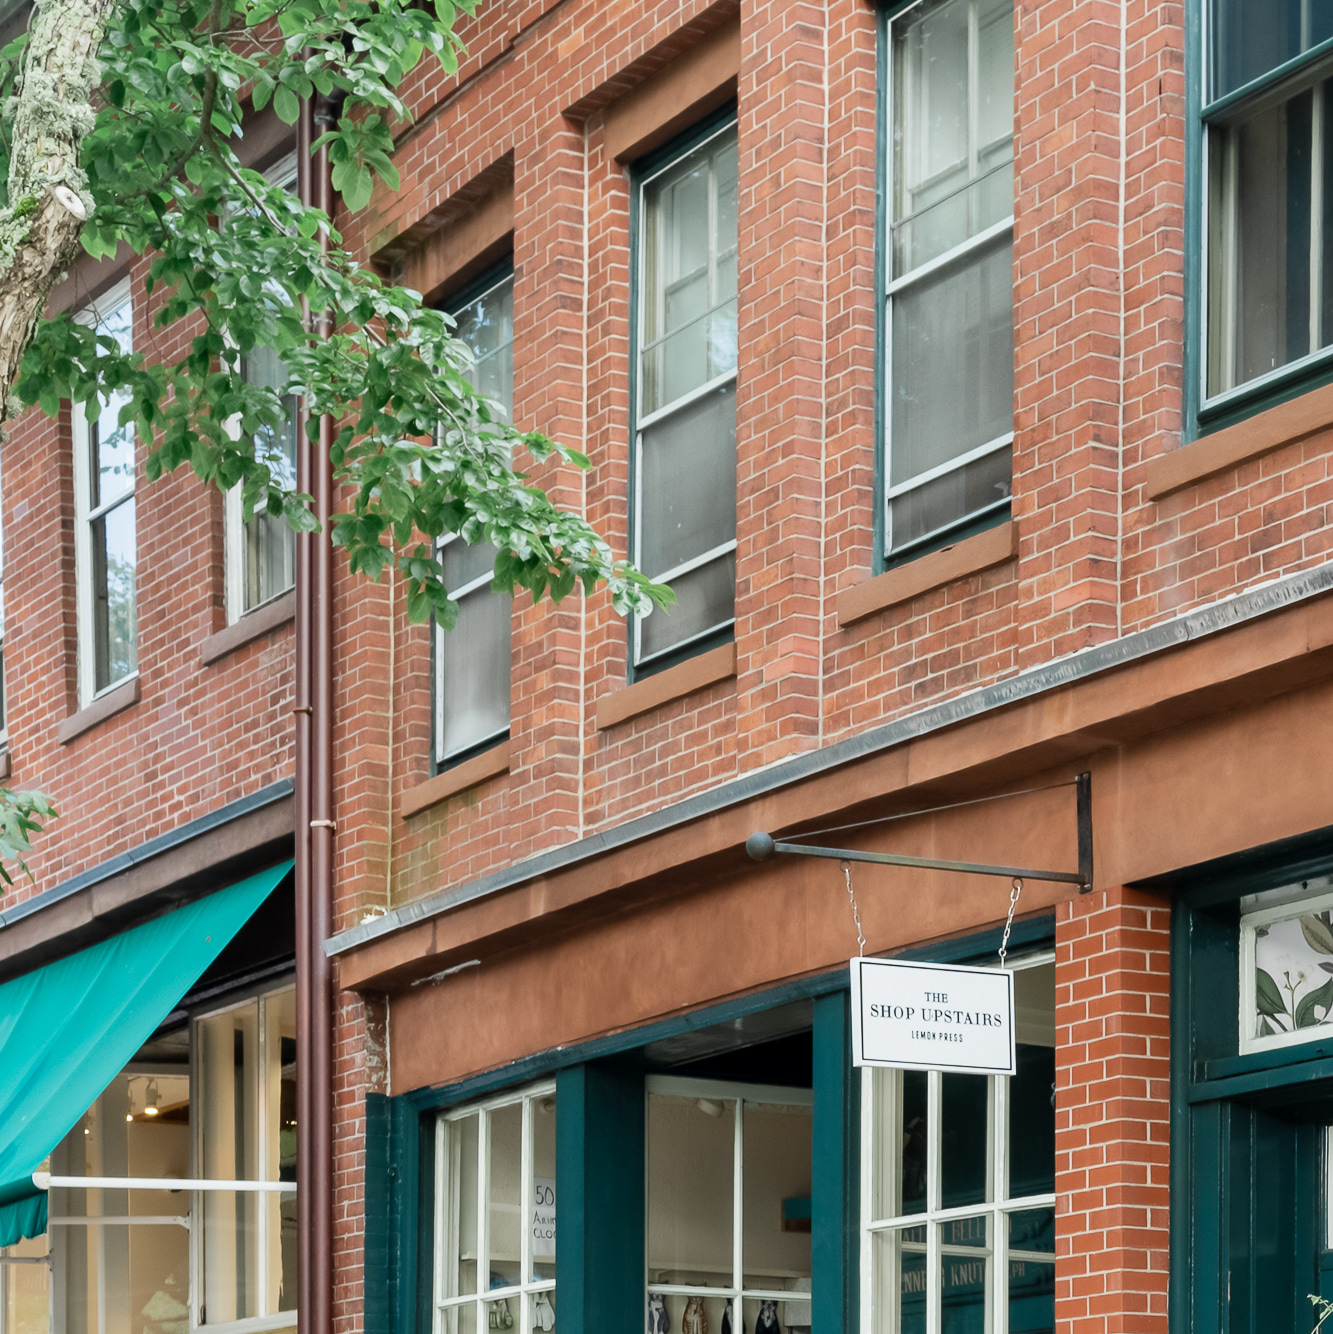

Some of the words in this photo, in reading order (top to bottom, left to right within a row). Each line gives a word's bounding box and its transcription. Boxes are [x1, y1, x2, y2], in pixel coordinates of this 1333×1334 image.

[924, 991, 949, 1004] THE
[870, 1004, 915, 1021] SHOP
[921, 1008, 1002, 1028] UPSTAIRS
[911, 1029, 936, 1042] LEMON
[939, 1032, 964, 1043] PRESS
